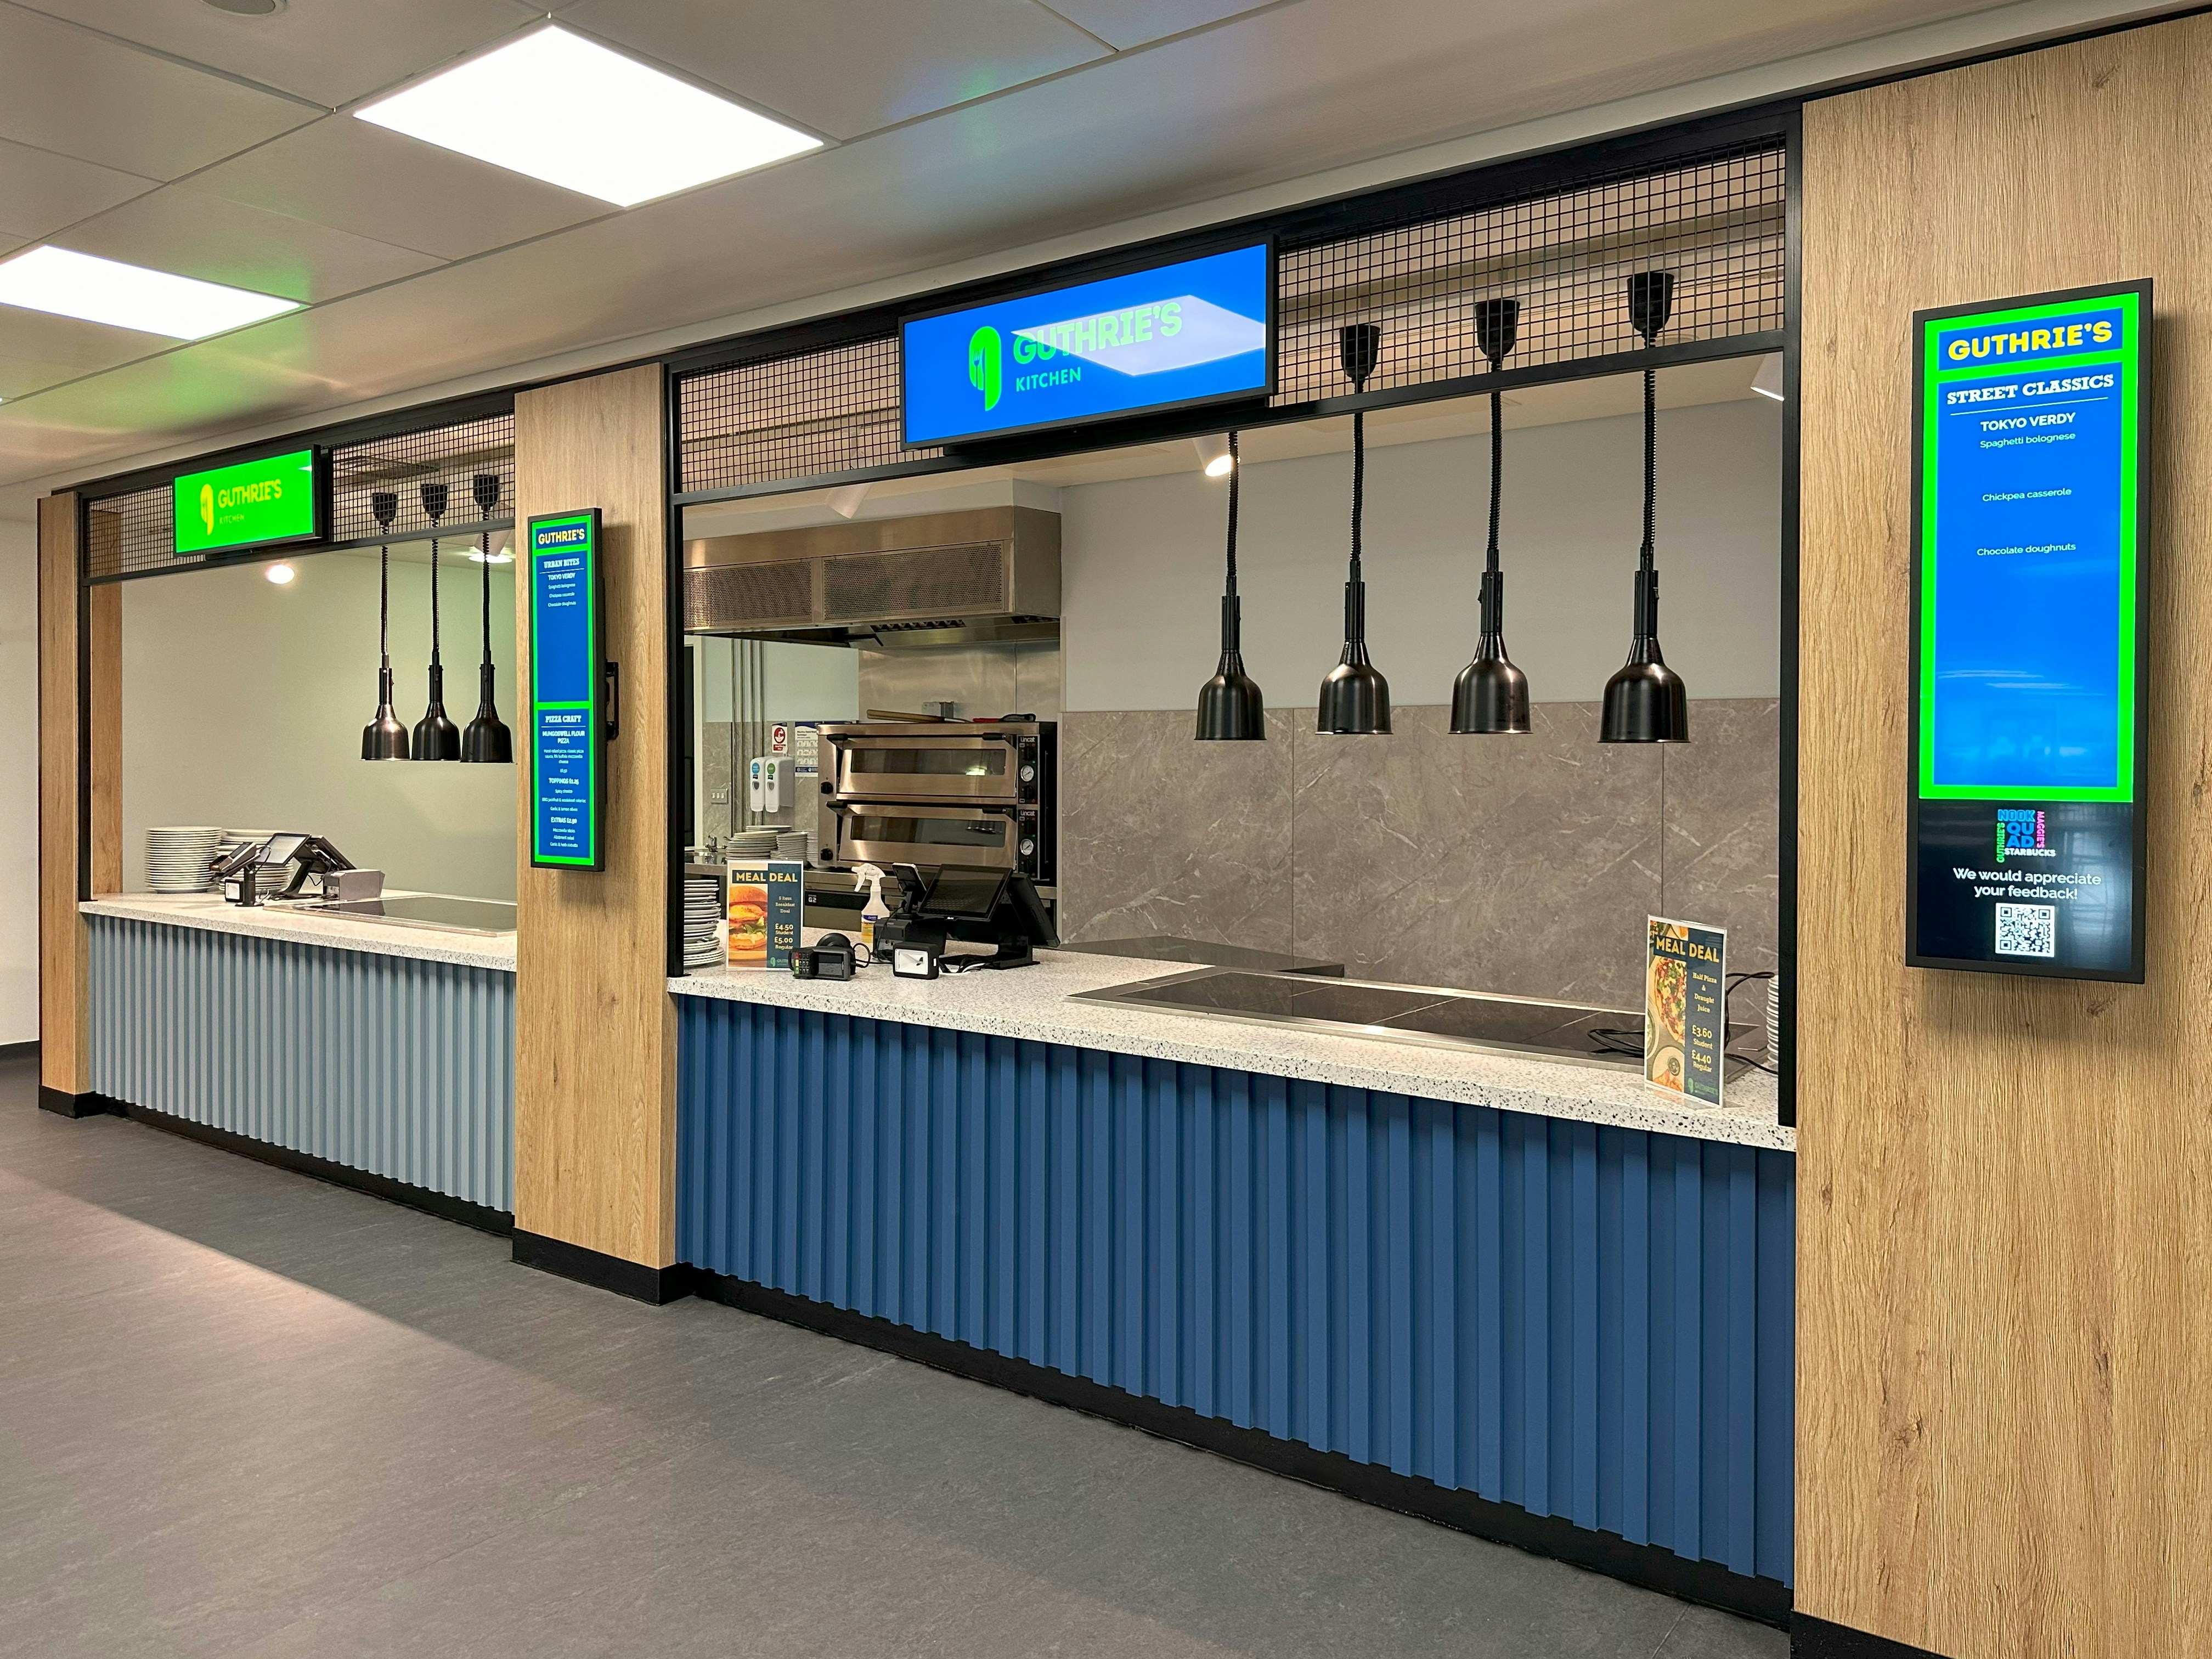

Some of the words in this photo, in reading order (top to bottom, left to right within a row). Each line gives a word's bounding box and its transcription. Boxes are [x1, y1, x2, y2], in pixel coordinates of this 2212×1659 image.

[1013, 302, 1183, 365] GUTHRIE'S
[1948, 321, 2113, 361] GUTHRIE'S
[1015, 366, 1082, 392] KITCHEN
[1947, 385, 2019, 405] STREET
[2022, 374, 2114, 397] CLASSICS
[1980, 417, 2027, 432] TOKYO
[2029, 412, 2076, 427] VERDY
[1979, 436, 2024, 449] Spaghetti
[2025, 432, 2076, 445] bolognese
[218, 478, 283, 509] GUTHRIE'S
[1982, 491, 2025, 503] Chickpea
[2027, 488, 2072, 499] casserole
[538, 528, 585, 545] GUTHRIE'S
[1977, 545, 2024, 556] Chocolate
[2025, 542, 2076, 554] doughnuts
[544, 560, 562, 568] URBAN
[563, 558, 580, 567] BITES
[545, 715, 562, 723] PIZZA
[562, 715, 582, 723] CRAFT
[1997, 809, 2036, 822] NOOK
[2006, 822, 2034, 836] QU
[2036, 811, 2045, 848] MAGGIE'S
[1996, 822, 2006, 863] GUTHRIE'S
[2006, 836, 2034, 848] AD
[2004, 848, 2056, 857] STARBUCKS
[736, 872, 766, 882] MEAL
[769, 873, 798, 882] DEAL
[1953, 867, 1977, 880] We
[1978, 870, 2022, 883] would
[2024, 872, 2102, 886] appreciate
[1974, 887, 2006, 898] your
[2007, 885, 2078, 900] feedback!
[774, 936, 793, 944] £5.00
[1656, 936, 1686, 956] MEAL
[1689, 943, 1720, 963] DEAL
[1692, 972, 1703, 981] Half
[1703, 974, 1717, 984] Pizza
[1694, 994, 1715, 1005] Draught
[1697, 1004, 1711, 1013] Juice
[1691, 1024, 1712, 1039] £3.60
[1693, 1039, 1714, 1050] Student
[1691, 1049, 1712, 1064] £4.40
[1692, 1061, 1713, 1073] Regular
